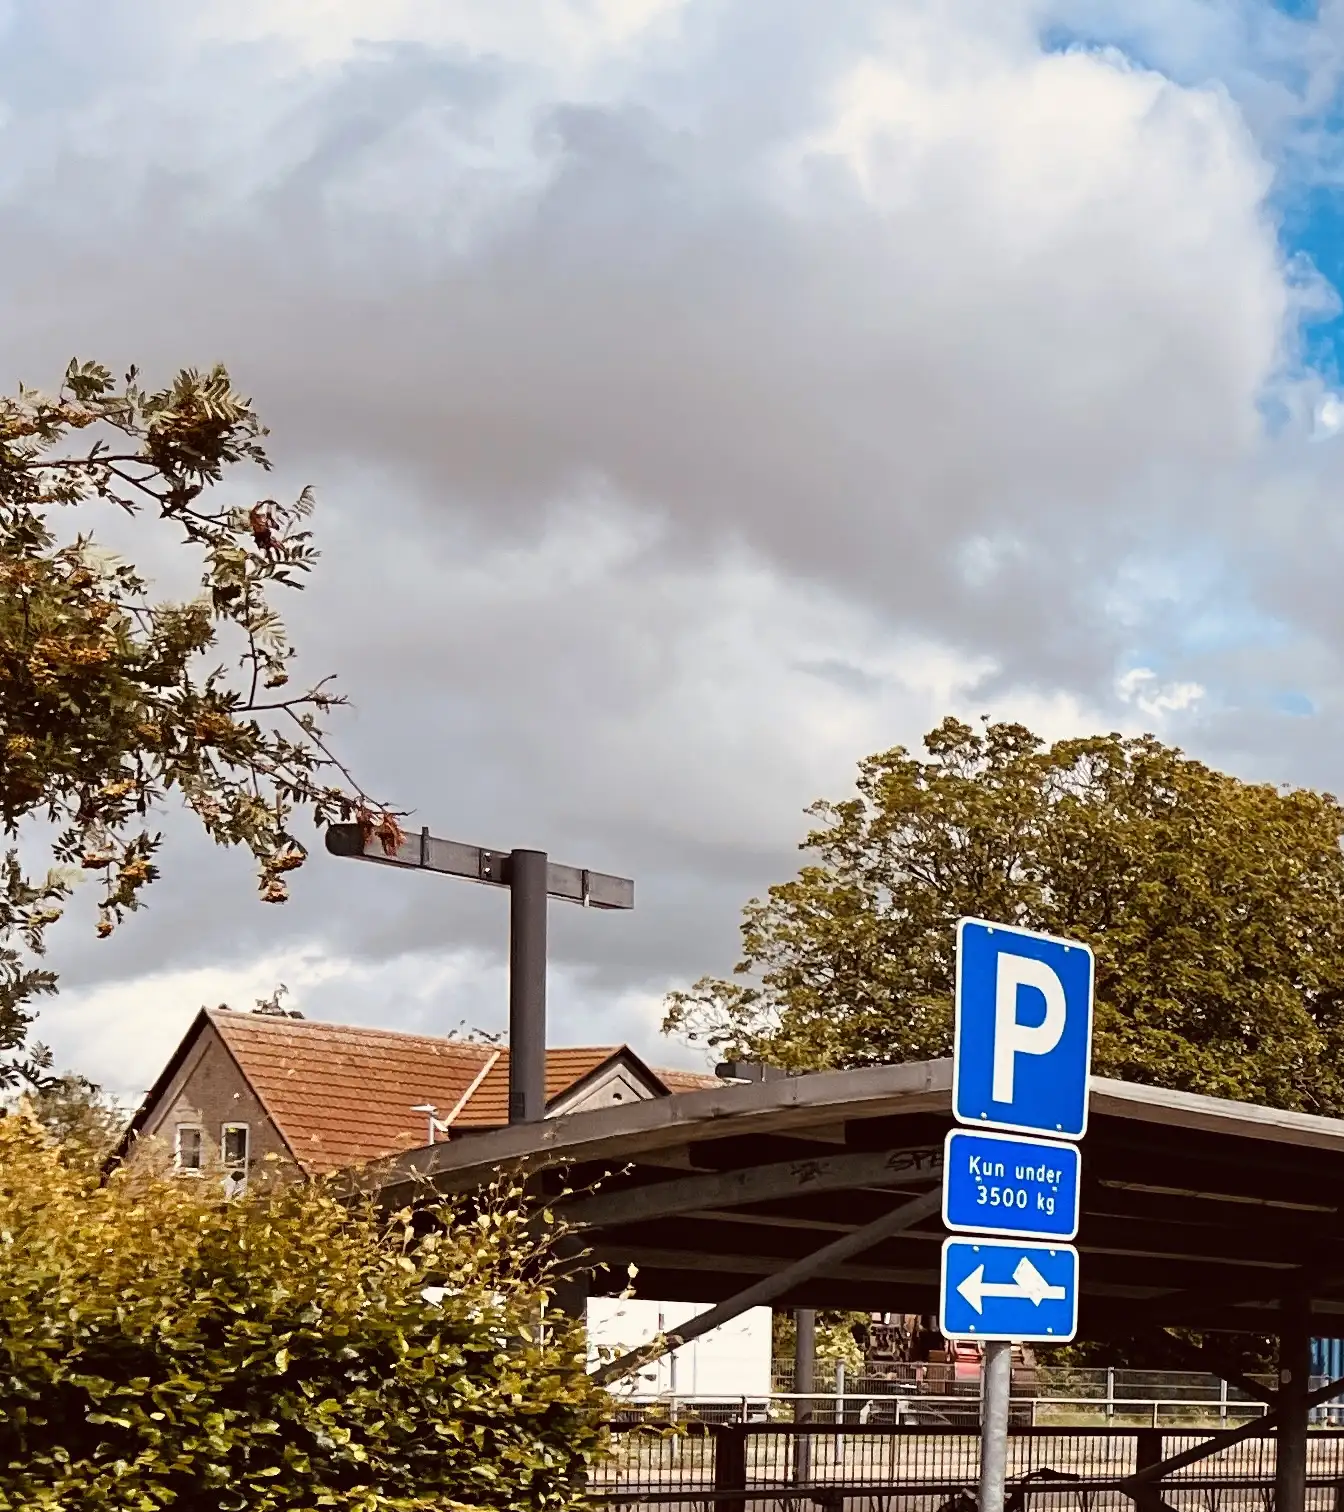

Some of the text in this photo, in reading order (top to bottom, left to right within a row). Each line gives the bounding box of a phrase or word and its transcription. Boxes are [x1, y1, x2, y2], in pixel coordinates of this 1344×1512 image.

[992, 951, 1067, 1104] P
[969, 1155, 1062, 1184] Kun under
[976, 1185, 1055, 1216] 3500 kg
